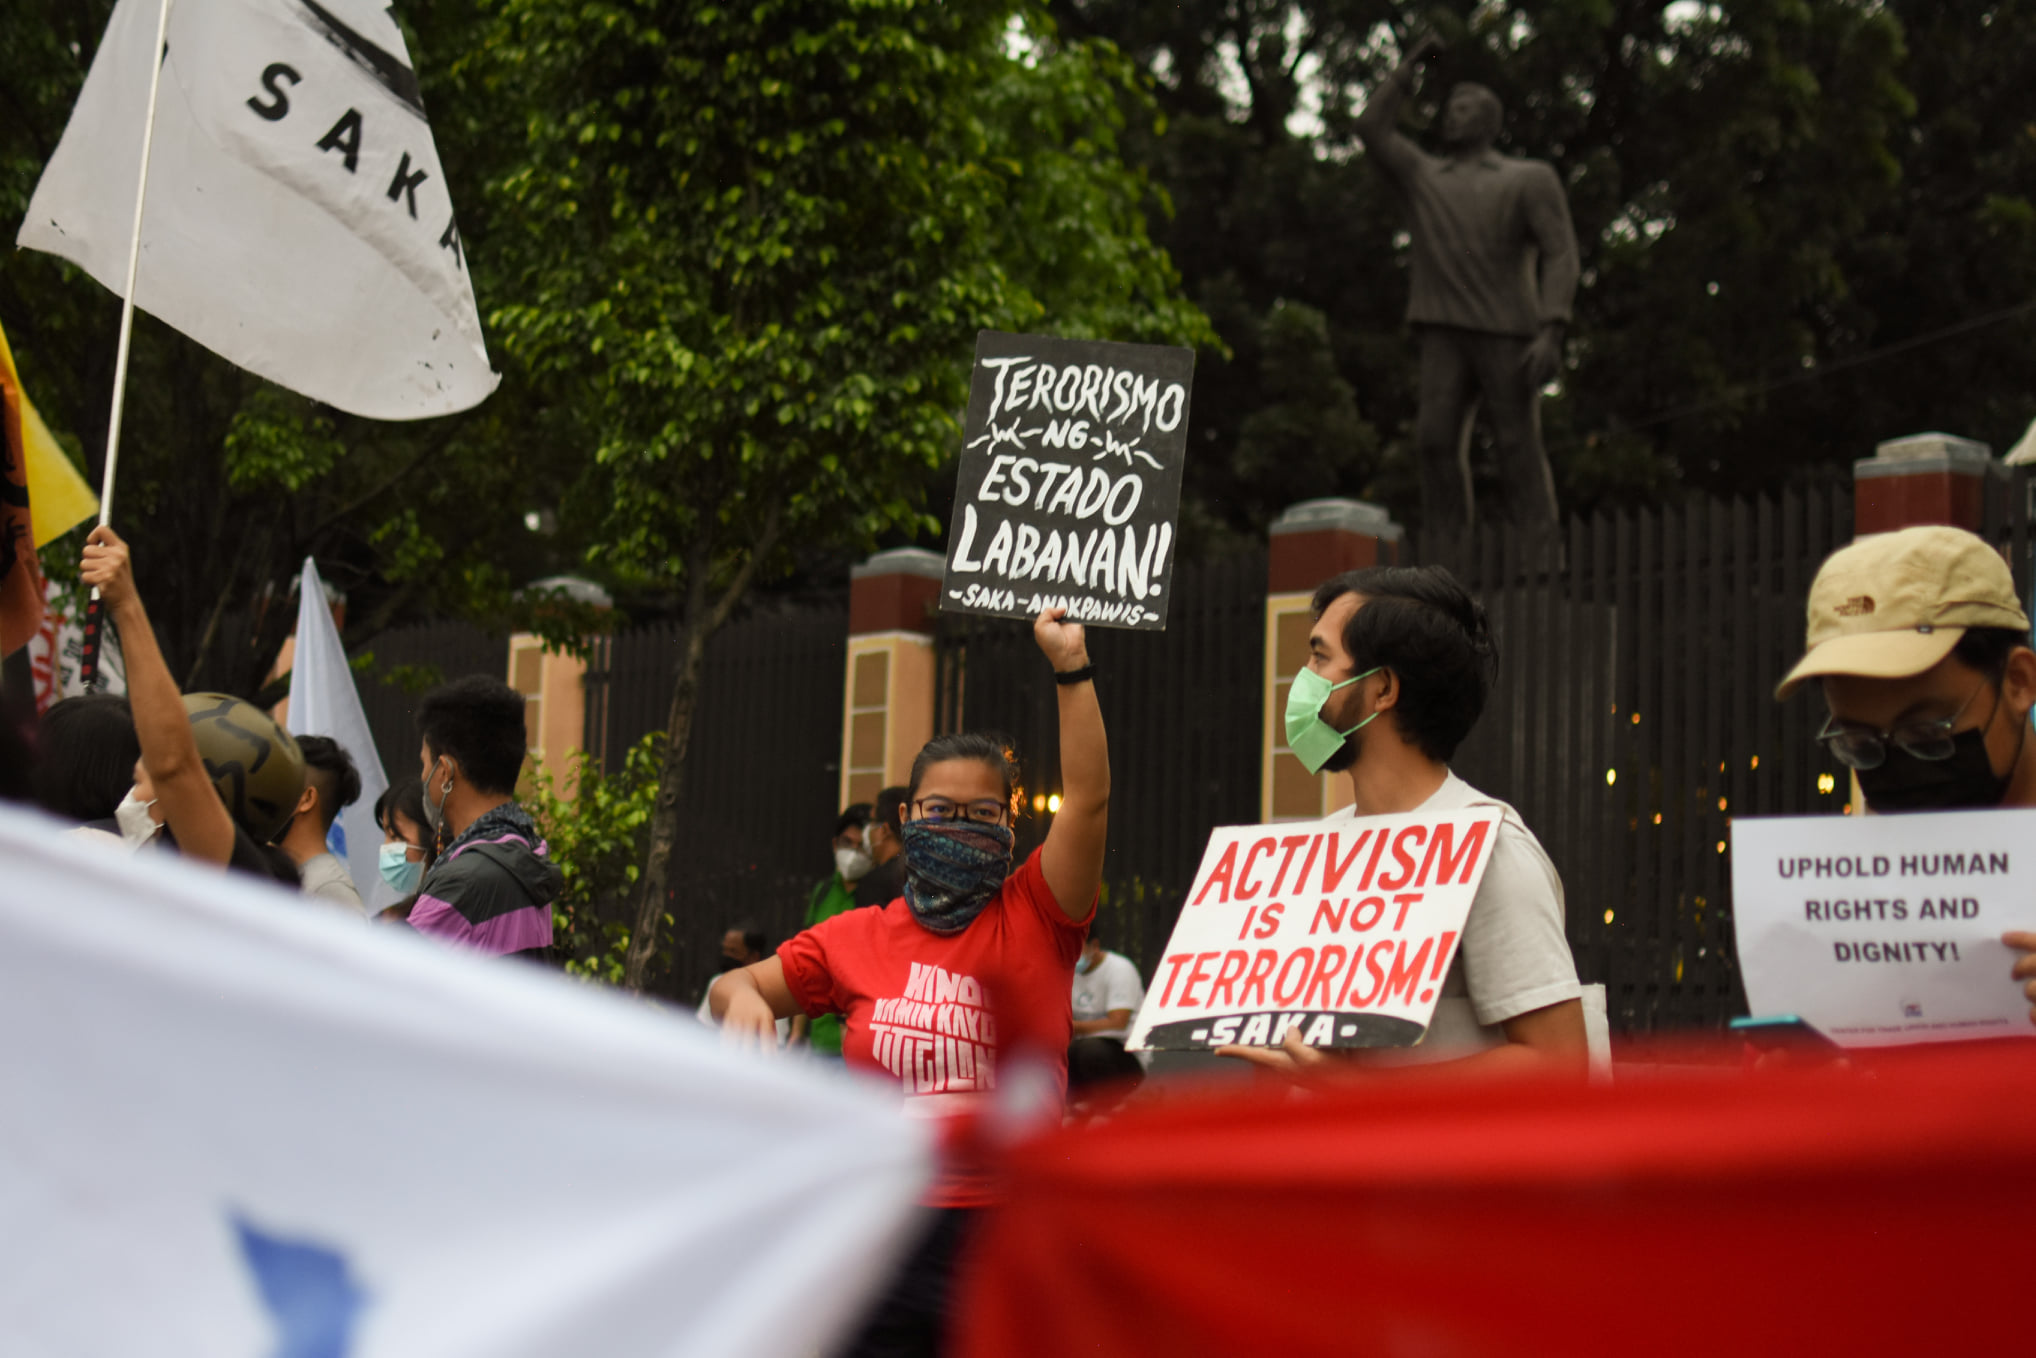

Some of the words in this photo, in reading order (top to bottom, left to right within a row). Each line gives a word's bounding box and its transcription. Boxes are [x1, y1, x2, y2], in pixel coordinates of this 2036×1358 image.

[246, 62, 462, 271] SAKA
[981, 356, 1185, 434] TERORISMO
[978, 455, 1142, 525] ESTADO
[952, 503, 1172, 600] LABANAN!
[1192, 820, 1491, 905] ACTIVISM
[1778, 856, 1890, 879] UPHOLD
[1900, 853, 2009, 877] HUMAN
[1238, 902, 1286, 940] IS
[1309, 893, 1424, 935] NOT
[1805, 899, 1909, 921] RIGHTS
[1919, 898, 1980, 920] AND
[1159, 931, 1458, 1011] TERRORISM!
[1834, 941, 1961, 963] DIGNITY!
[872, 997, 936, 1031] NAMIN
